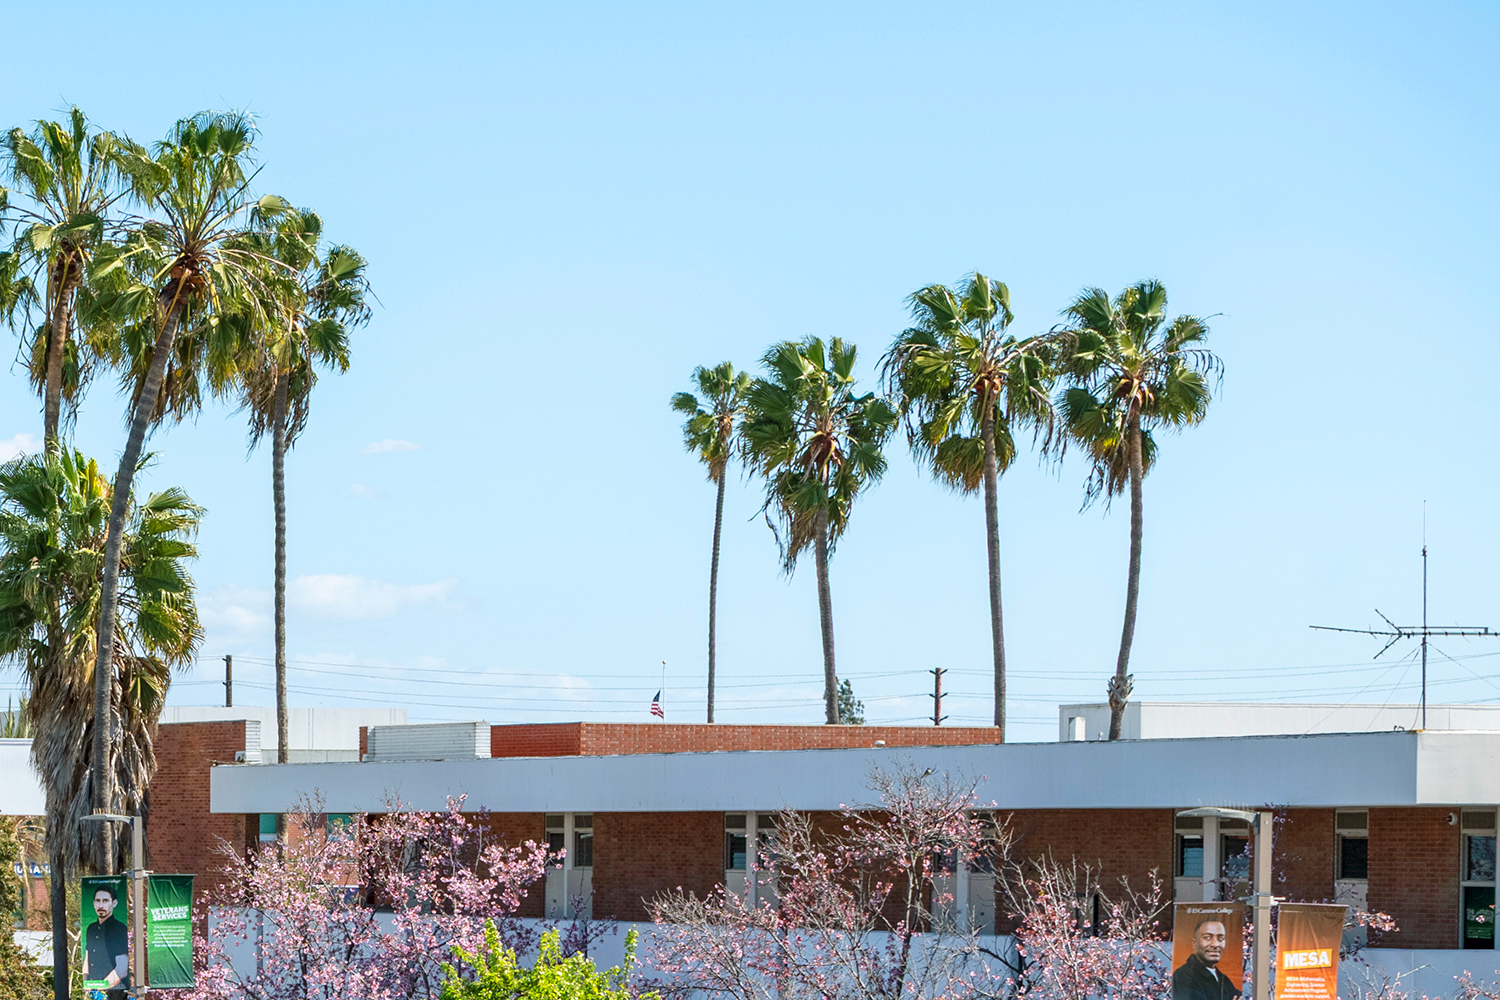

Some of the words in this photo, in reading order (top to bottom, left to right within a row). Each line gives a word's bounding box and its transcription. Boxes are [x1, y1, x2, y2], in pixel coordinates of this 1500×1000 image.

[151, 905, 189, 916] VETERANS
[152, 912, 187, 922] SERVICES
[1284, 951, 1330, 968] MESA
